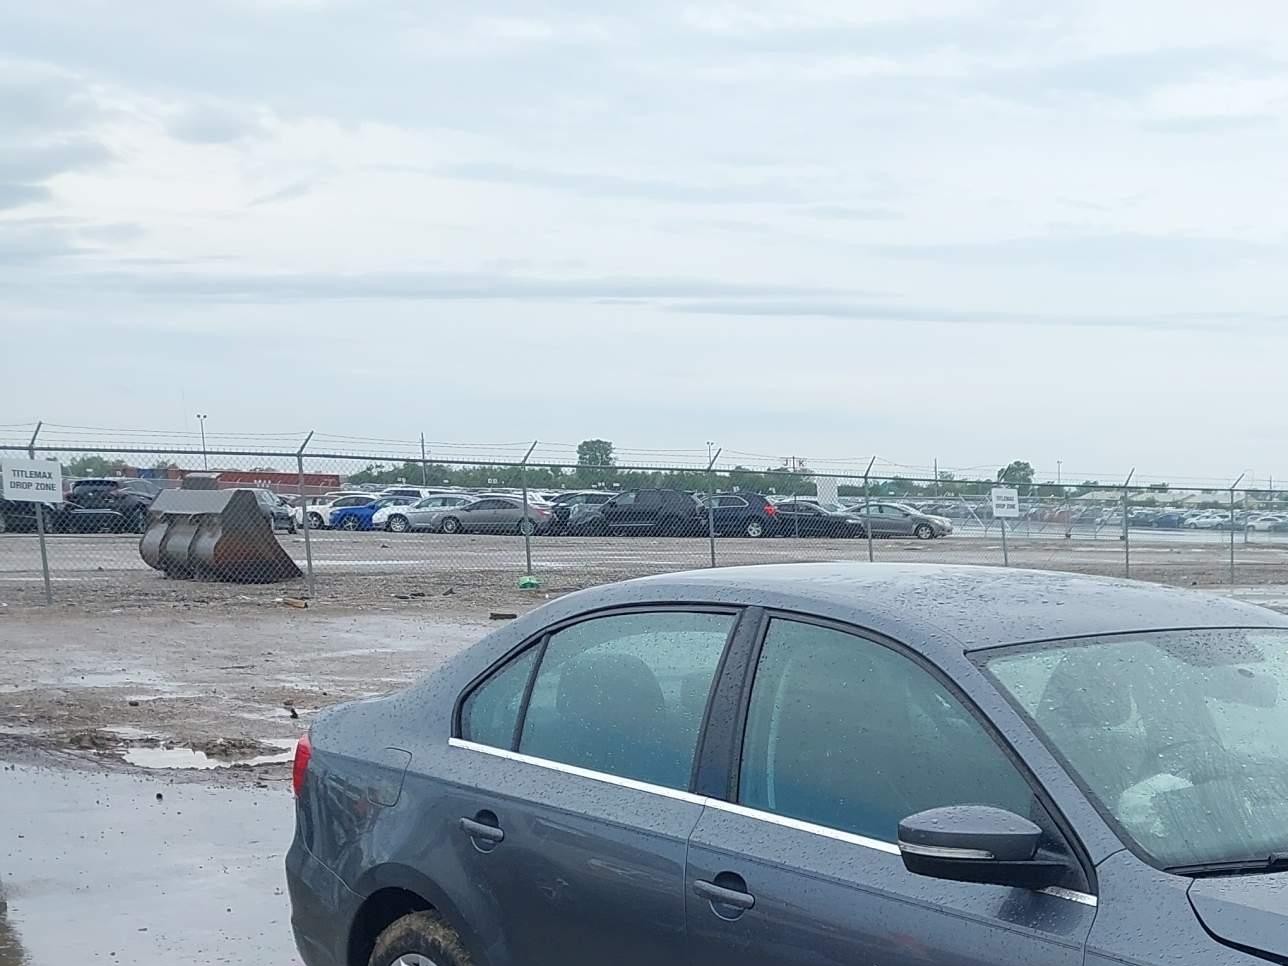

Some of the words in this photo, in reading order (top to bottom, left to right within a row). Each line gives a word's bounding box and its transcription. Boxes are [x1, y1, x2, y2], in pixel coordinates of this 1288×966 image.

[11, 469, 53, 479] TITLEMAX
[10, 481, 33, 489] DROP
[35, 482, 57, 491] ZONE
